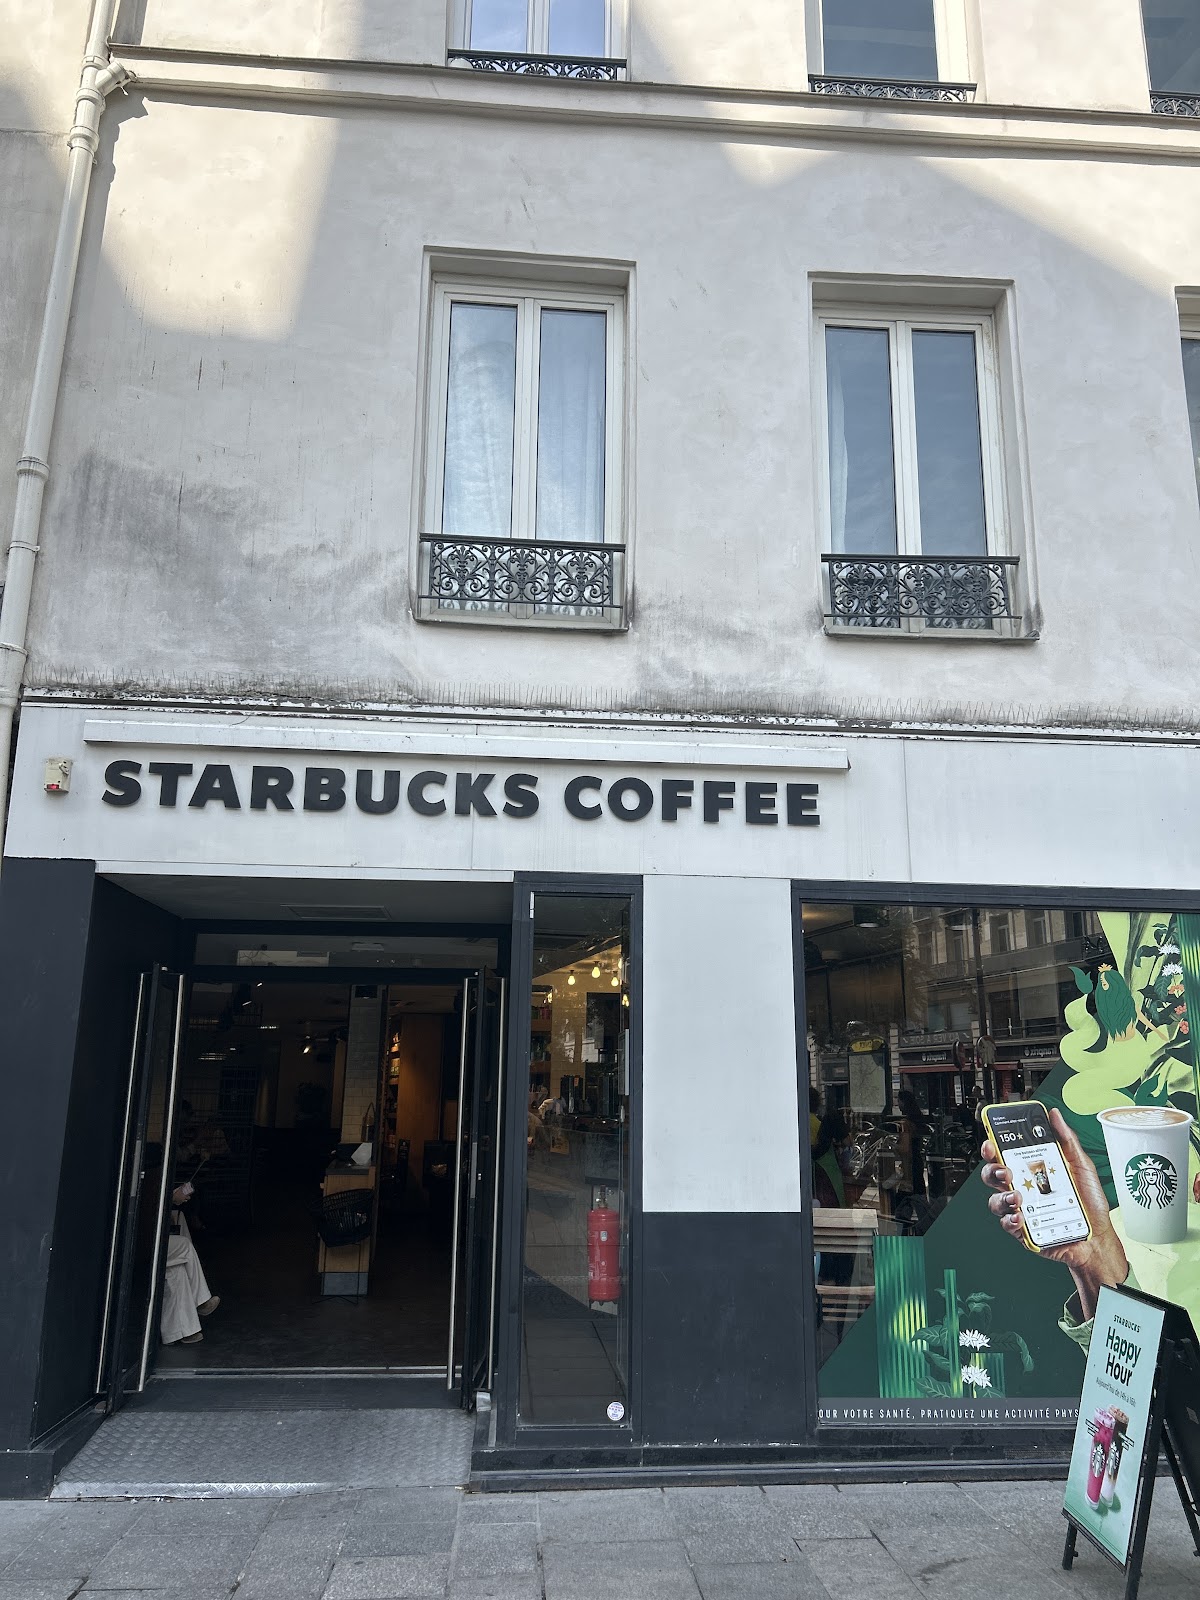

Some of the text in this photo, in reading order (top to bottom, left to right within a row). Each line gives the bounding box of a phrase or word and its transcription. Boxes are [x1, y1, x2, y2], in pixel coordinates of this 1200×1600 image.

[102, 759, 820, 827] STARBUCKS COFFEE
[999, 1132, 1017, 1143] 150
[1113, 1314, 1141, 1333] STARBUCKS
[1105, 1326, 1142, 1368] Happy
[1105, 1352, 1133, 1387] Hour
[843, 1409, 874, 1419] VOTRE
[879, 1407, 916, 1420] SANTÉ,
[920, 1409, 975, 1419] PRATIQUEZ
[980, 1409, 999, 1419] UNE
[1004, 1407, 1050, 1419] ACTIVITÉ
